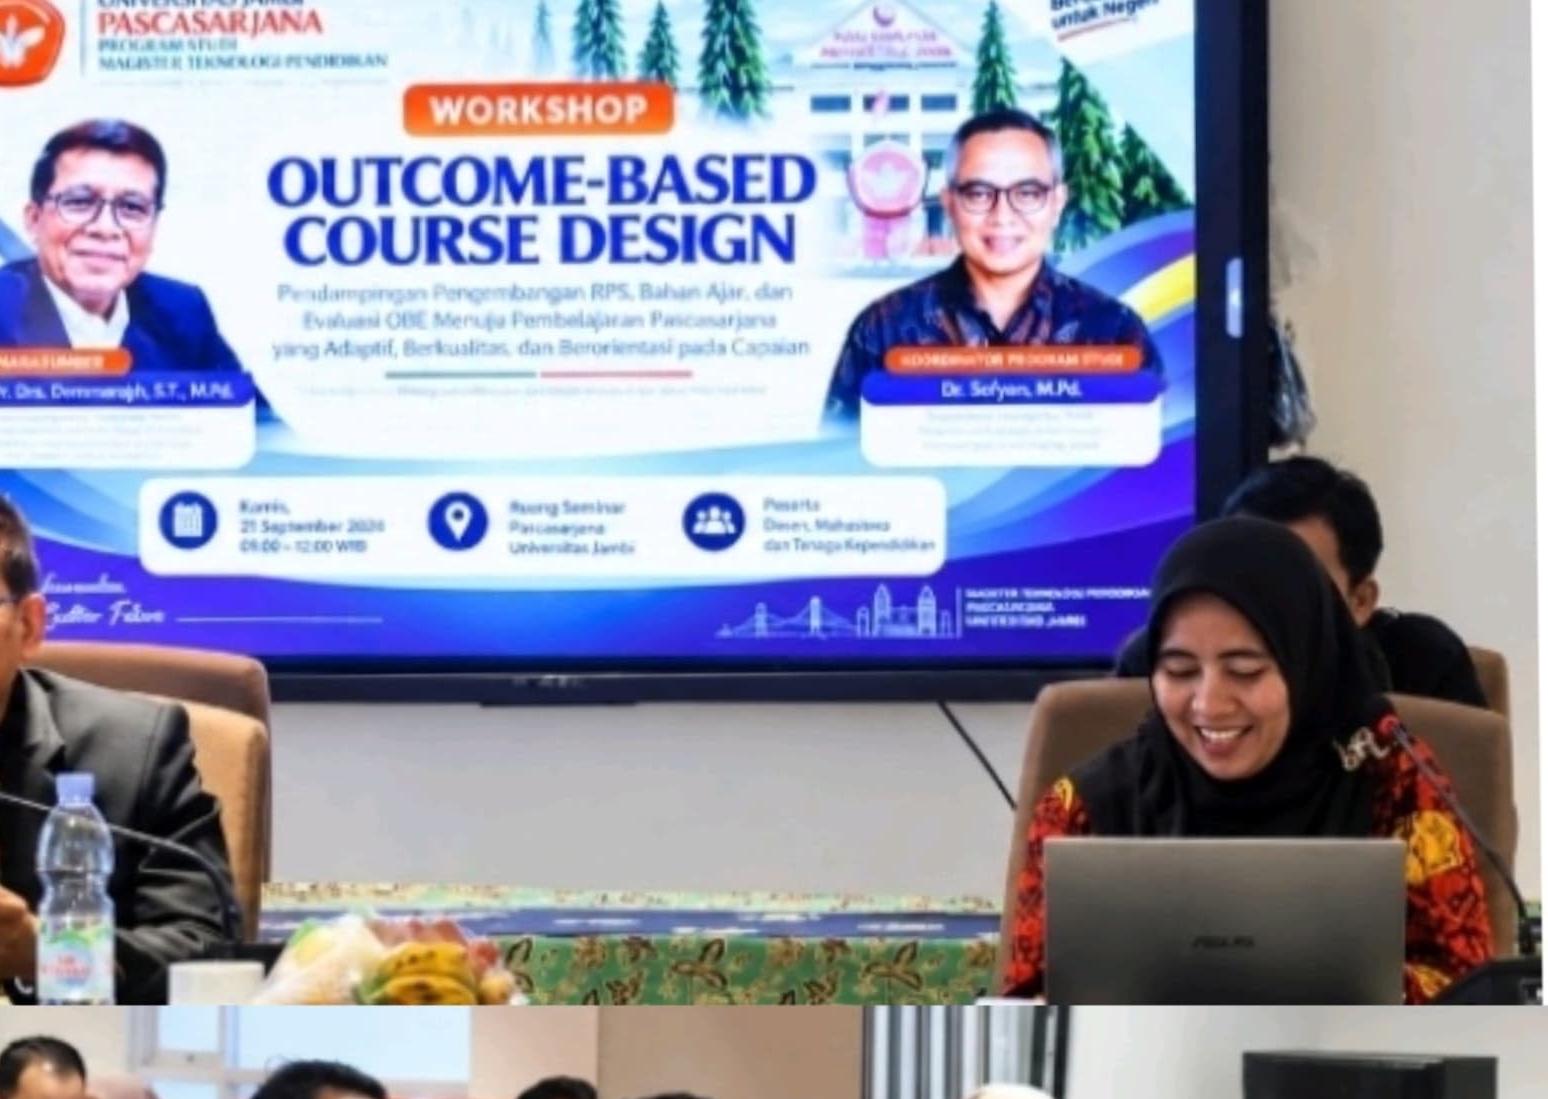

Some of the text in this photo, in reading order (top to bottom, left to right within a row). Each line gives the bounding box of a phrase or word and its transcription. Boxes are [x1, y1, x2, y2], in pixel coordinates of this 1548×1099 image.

[99, 10, 322, 35] PASCASARJANA
[431, 95, 646, 125] WORKSHOP
[267, 154, 817, 208] OUTCOME-BASED
[284, 212, 795, 266] COURSE DESIGN
[277, 284, 428, 306] Pendampingan
[639, 282, 701, 301] Bahan
[754, 282, 793, 300] dan
[272, 344, 320, 361] yang
[518, 339, 554, 356] dan
[678, 338, 727, 360] pada
